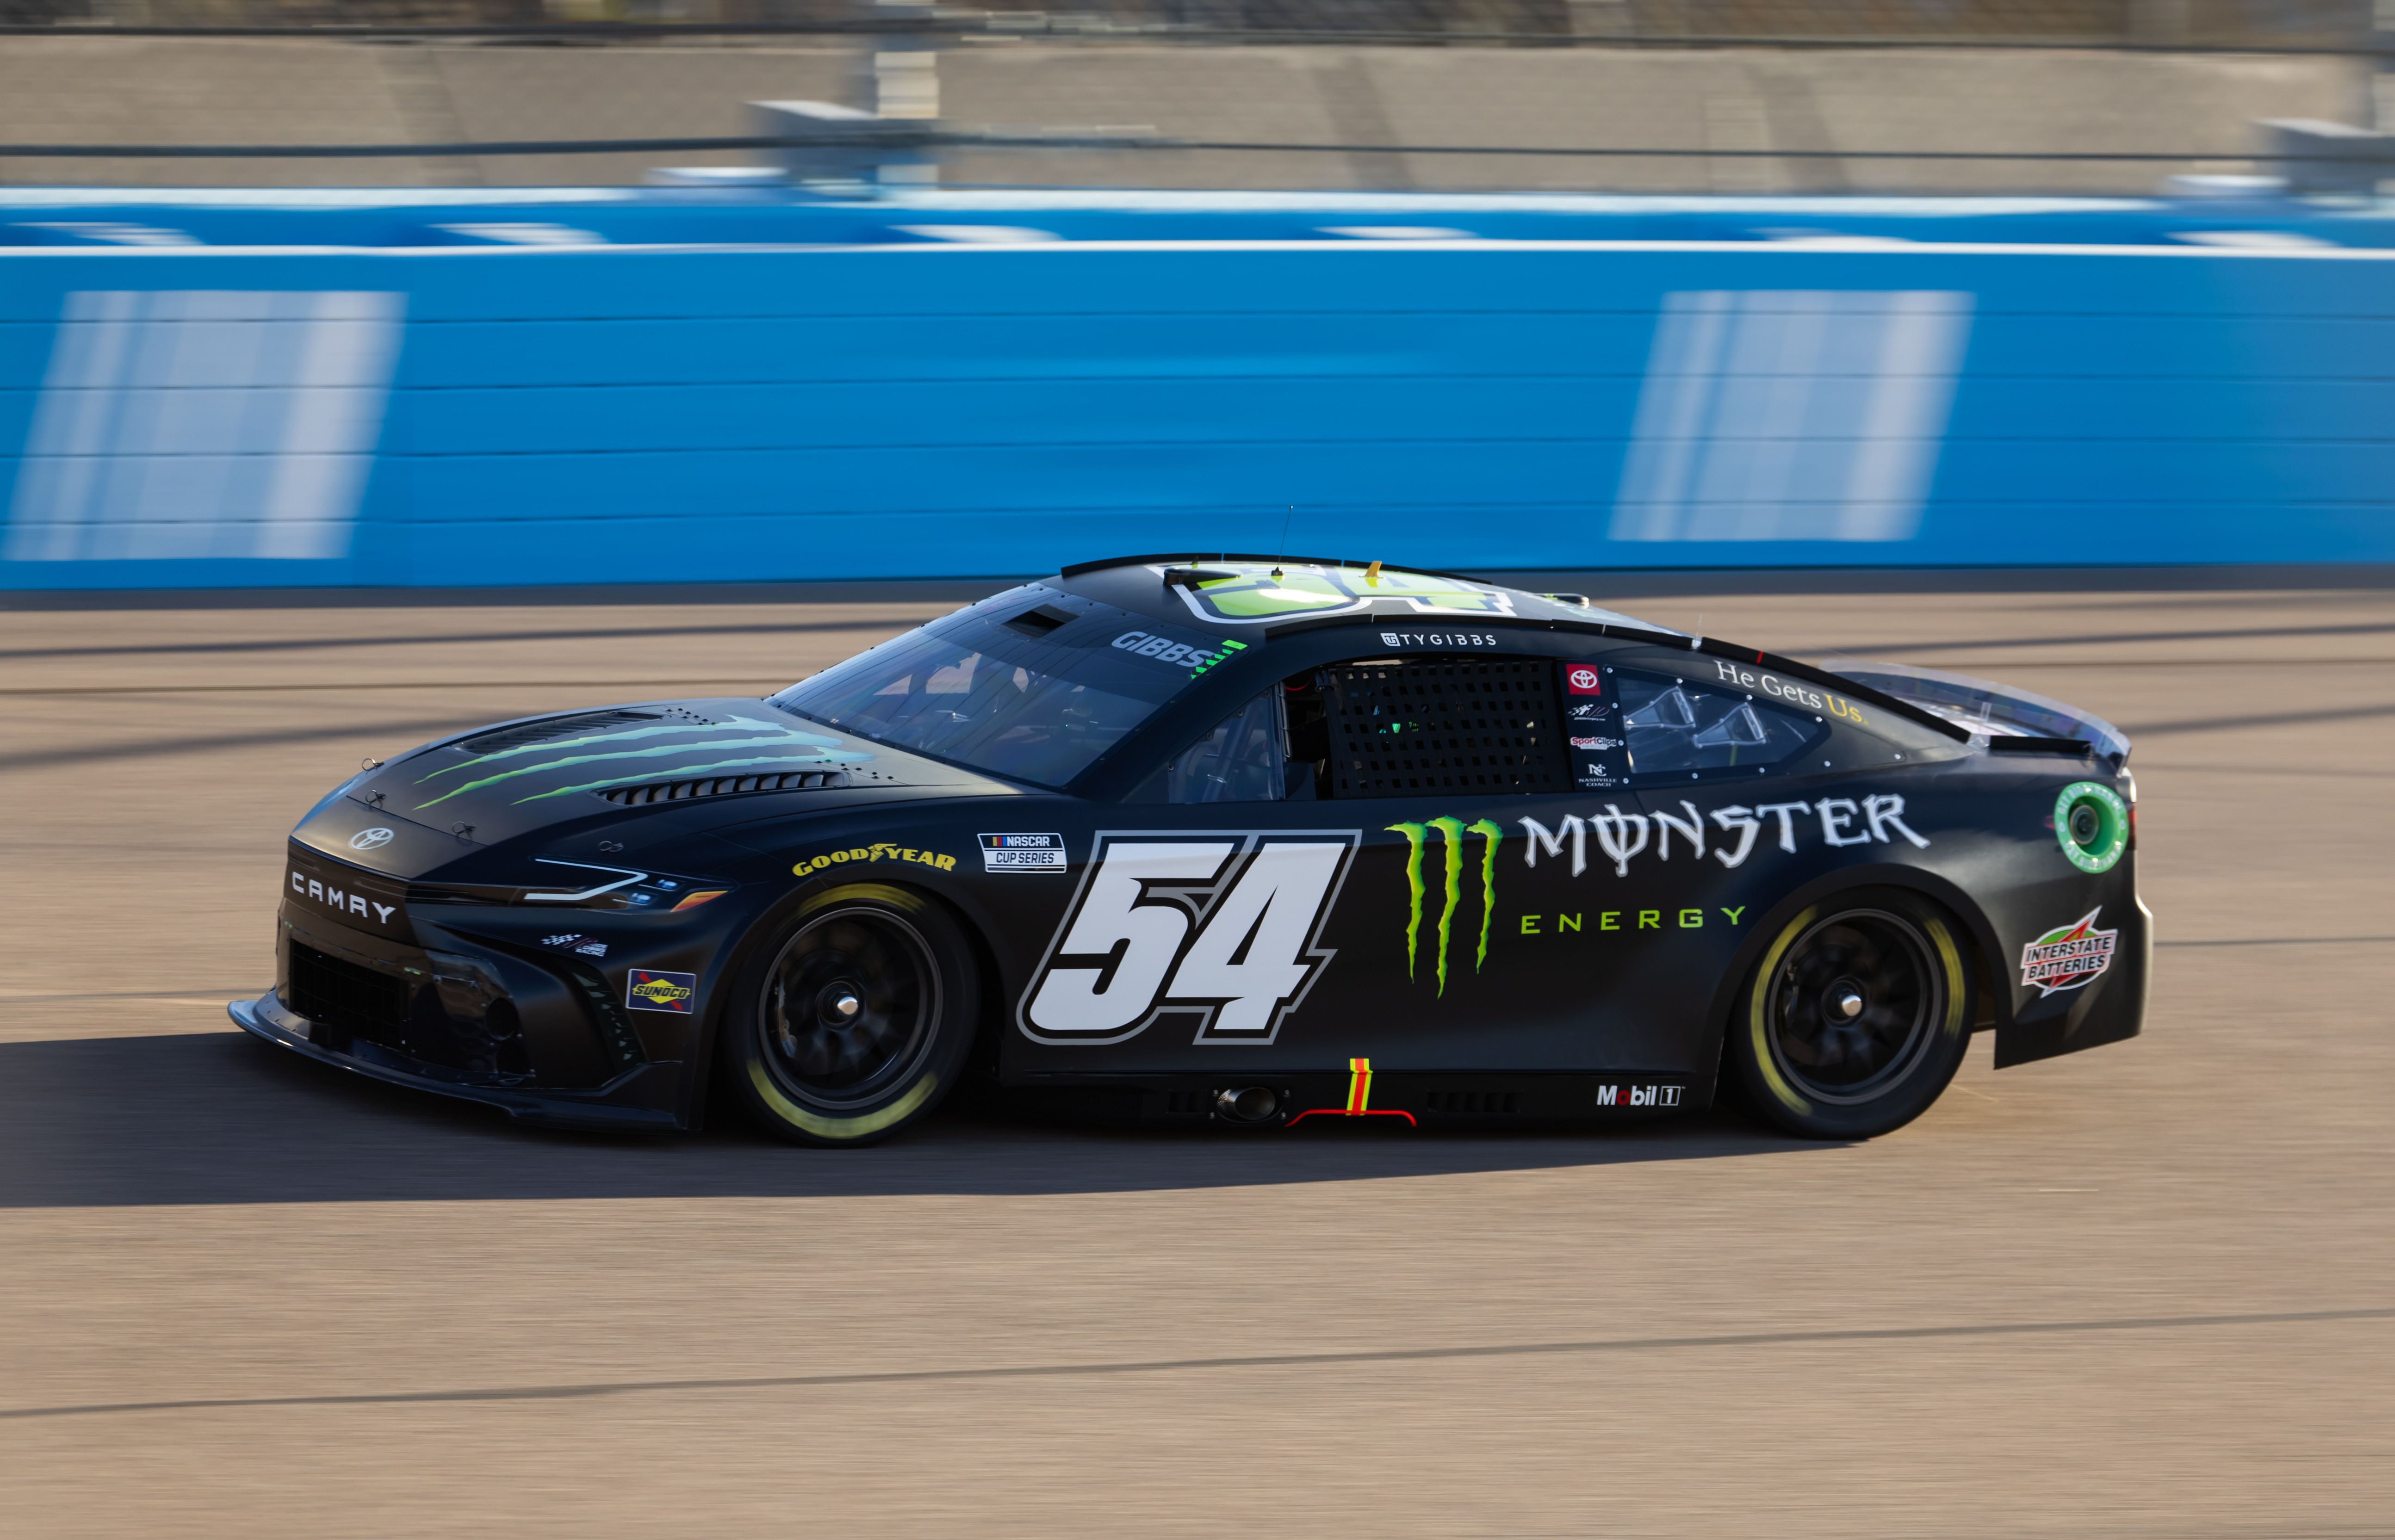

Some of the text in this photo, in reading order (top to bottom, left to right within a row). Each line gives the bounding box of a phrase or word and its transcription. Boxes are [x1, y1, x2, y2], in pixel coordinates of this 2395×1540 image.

[1111, 631, 1216, 668] GIBBS
[1713, 659, 1869, 725] He Gets Us.
[1006, 836, 1050, 847] NASCAR
[1518, 794, 1931, 878] MONSTER
[792, 846, 956, 876] GOODYEAR
[996, 852, 1055, 864] CUP SERIES
[292, 871, 396, 924] CAMRY
[1520, 906, 1746, 934] ENERGY
[1024, 836, 1353, 1038] 54
[2028, 937, 2111, 962] INTERSTATE
[2029, 954, 2105, 979] BATTERIES
[635, 985, 688, 998] SUNOCO
[1597, 1085, 1657, 1106] Mobil
